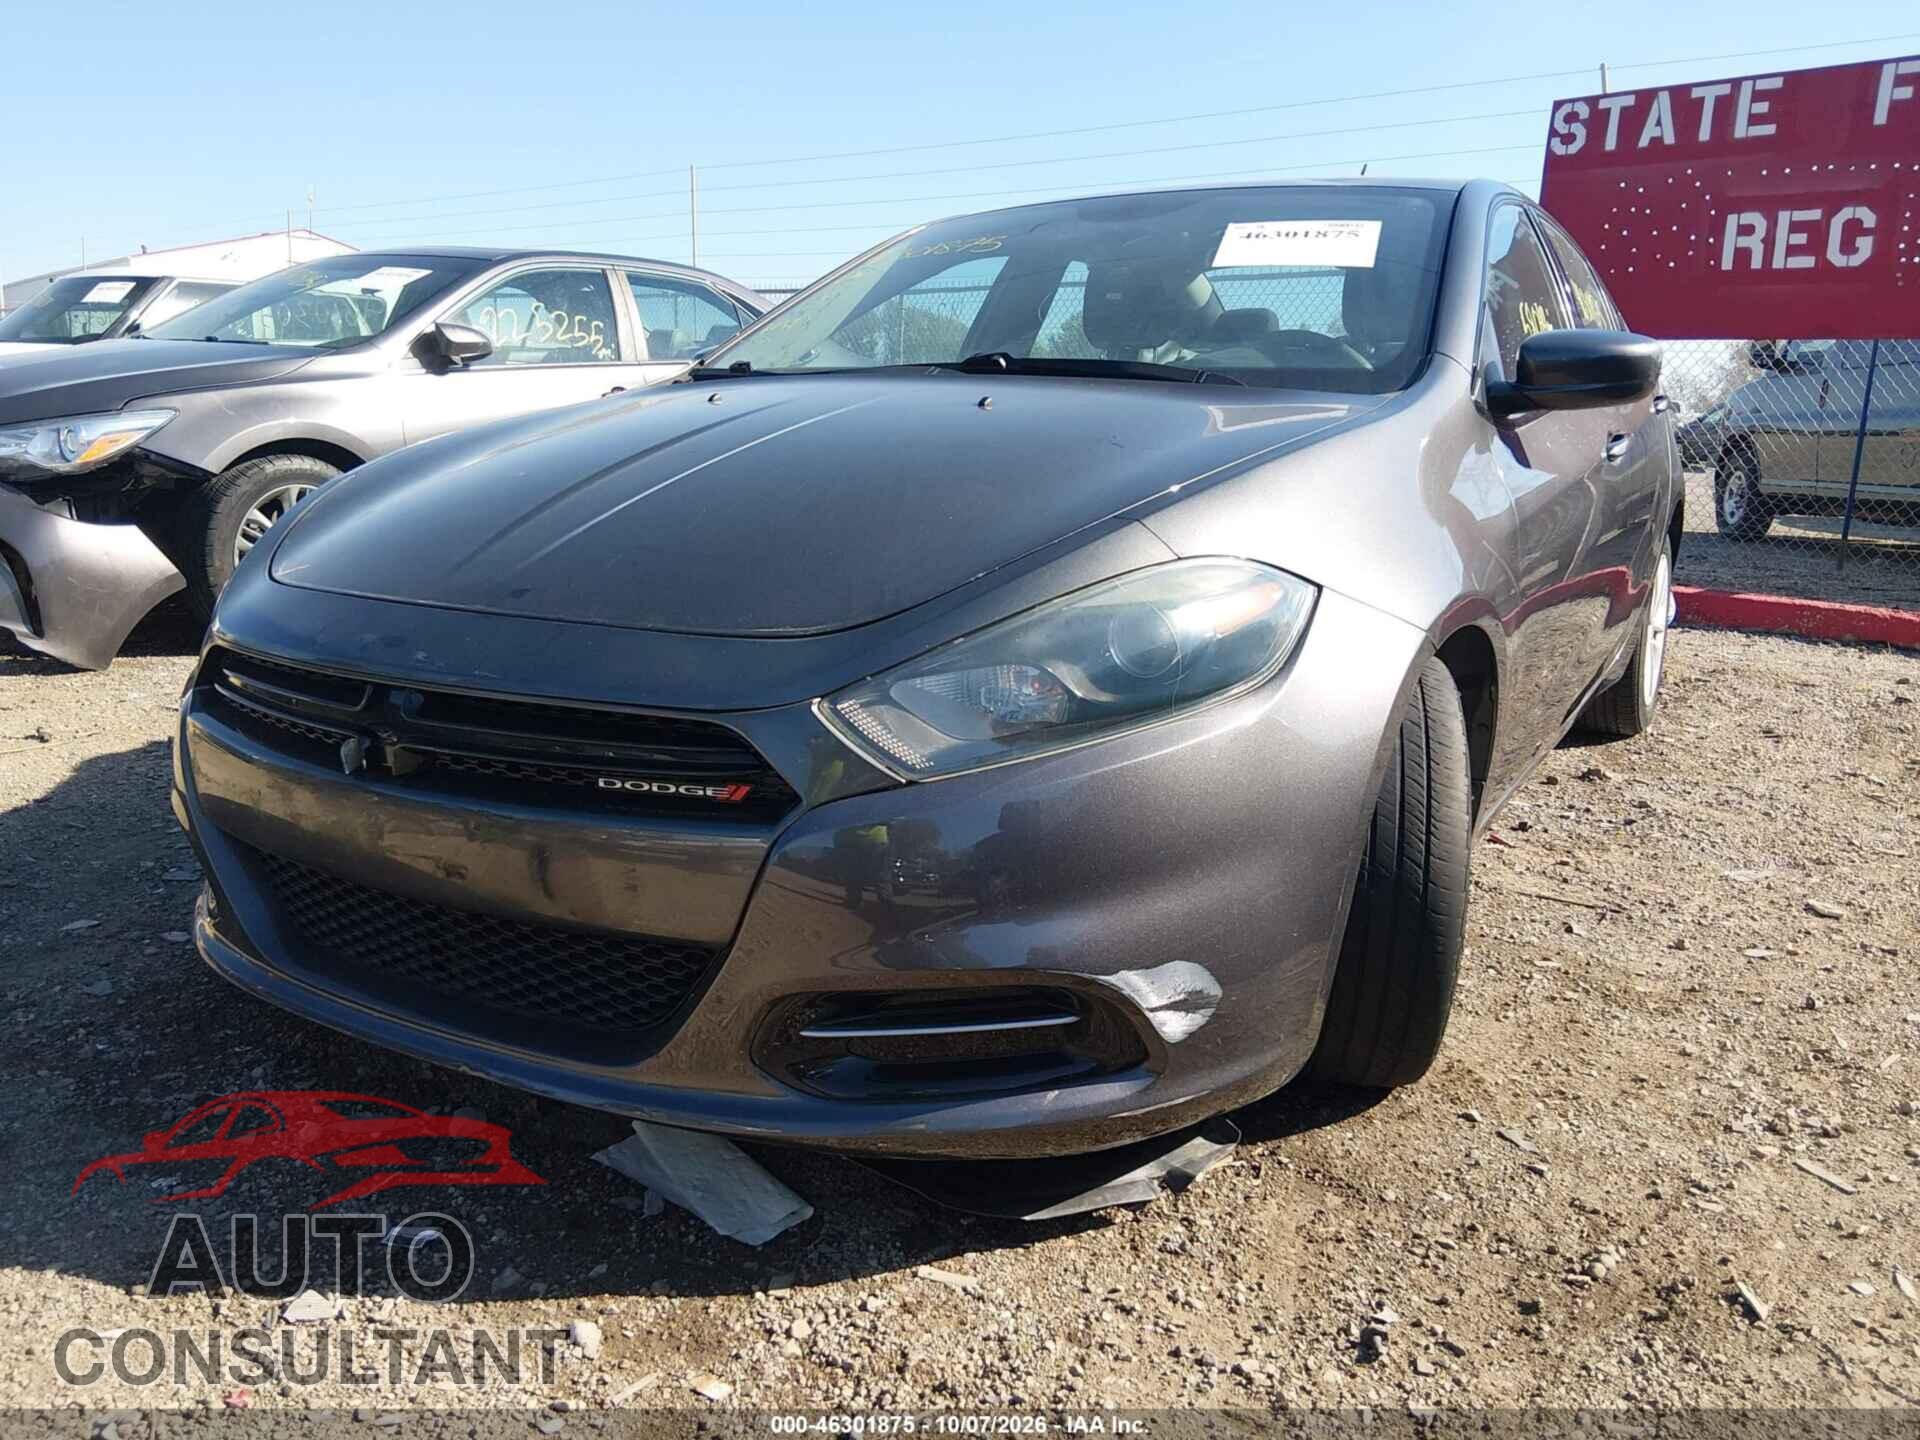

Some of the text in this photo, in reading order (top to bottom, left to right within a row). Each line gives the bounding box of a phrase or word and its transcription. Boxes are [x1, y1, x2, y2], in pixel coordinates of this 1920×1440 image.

[1550, 76, 1784, 156] STATE
[1721, 205, 1877, 271] REG
[598, 778, 730, 797] DODGE
